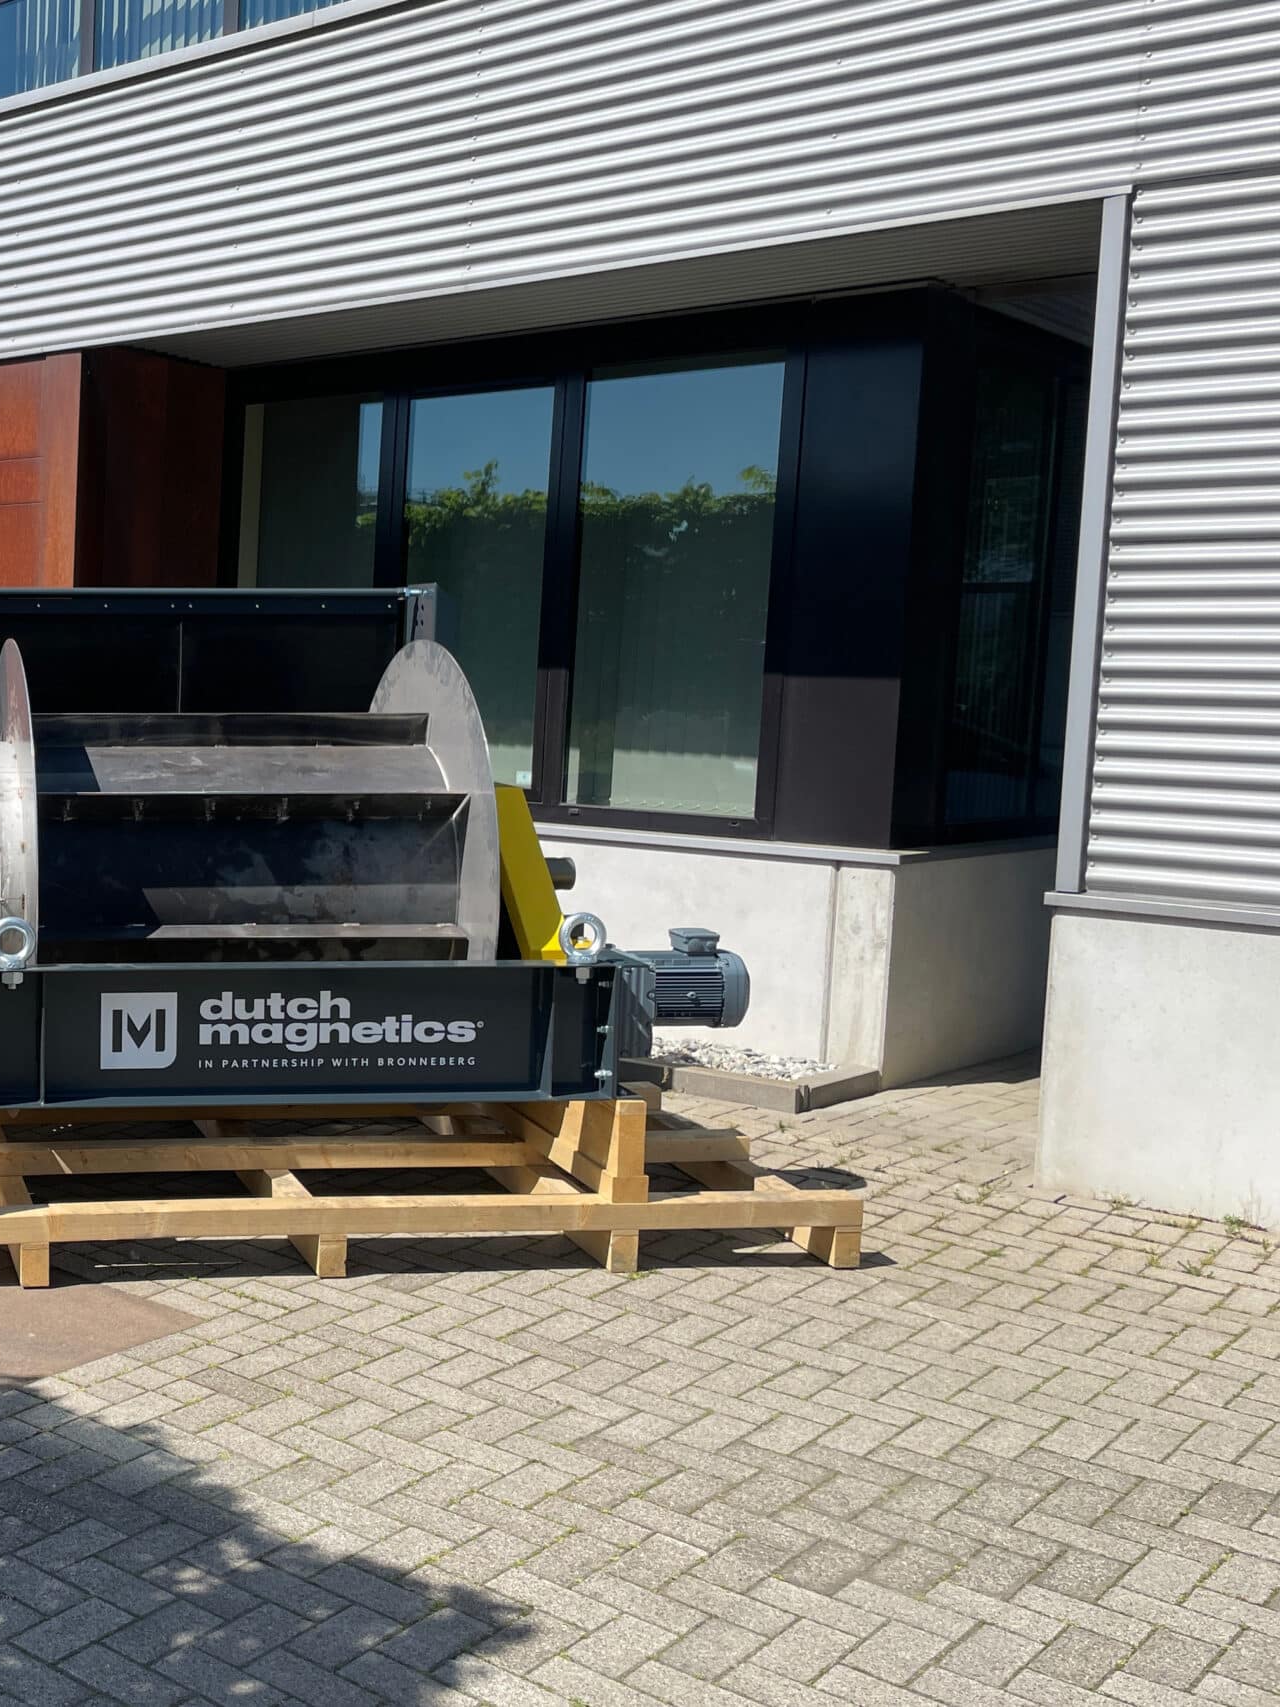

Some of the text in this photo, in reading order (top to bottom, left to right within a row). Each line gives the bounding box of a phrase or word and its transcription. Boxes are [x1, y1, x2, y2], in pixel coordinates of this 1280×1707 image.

[199, 991, 351, 1020] dutch
[198, 1056, 477, 1069] IN PARTNERSHIP WITH BRONNEBERG
